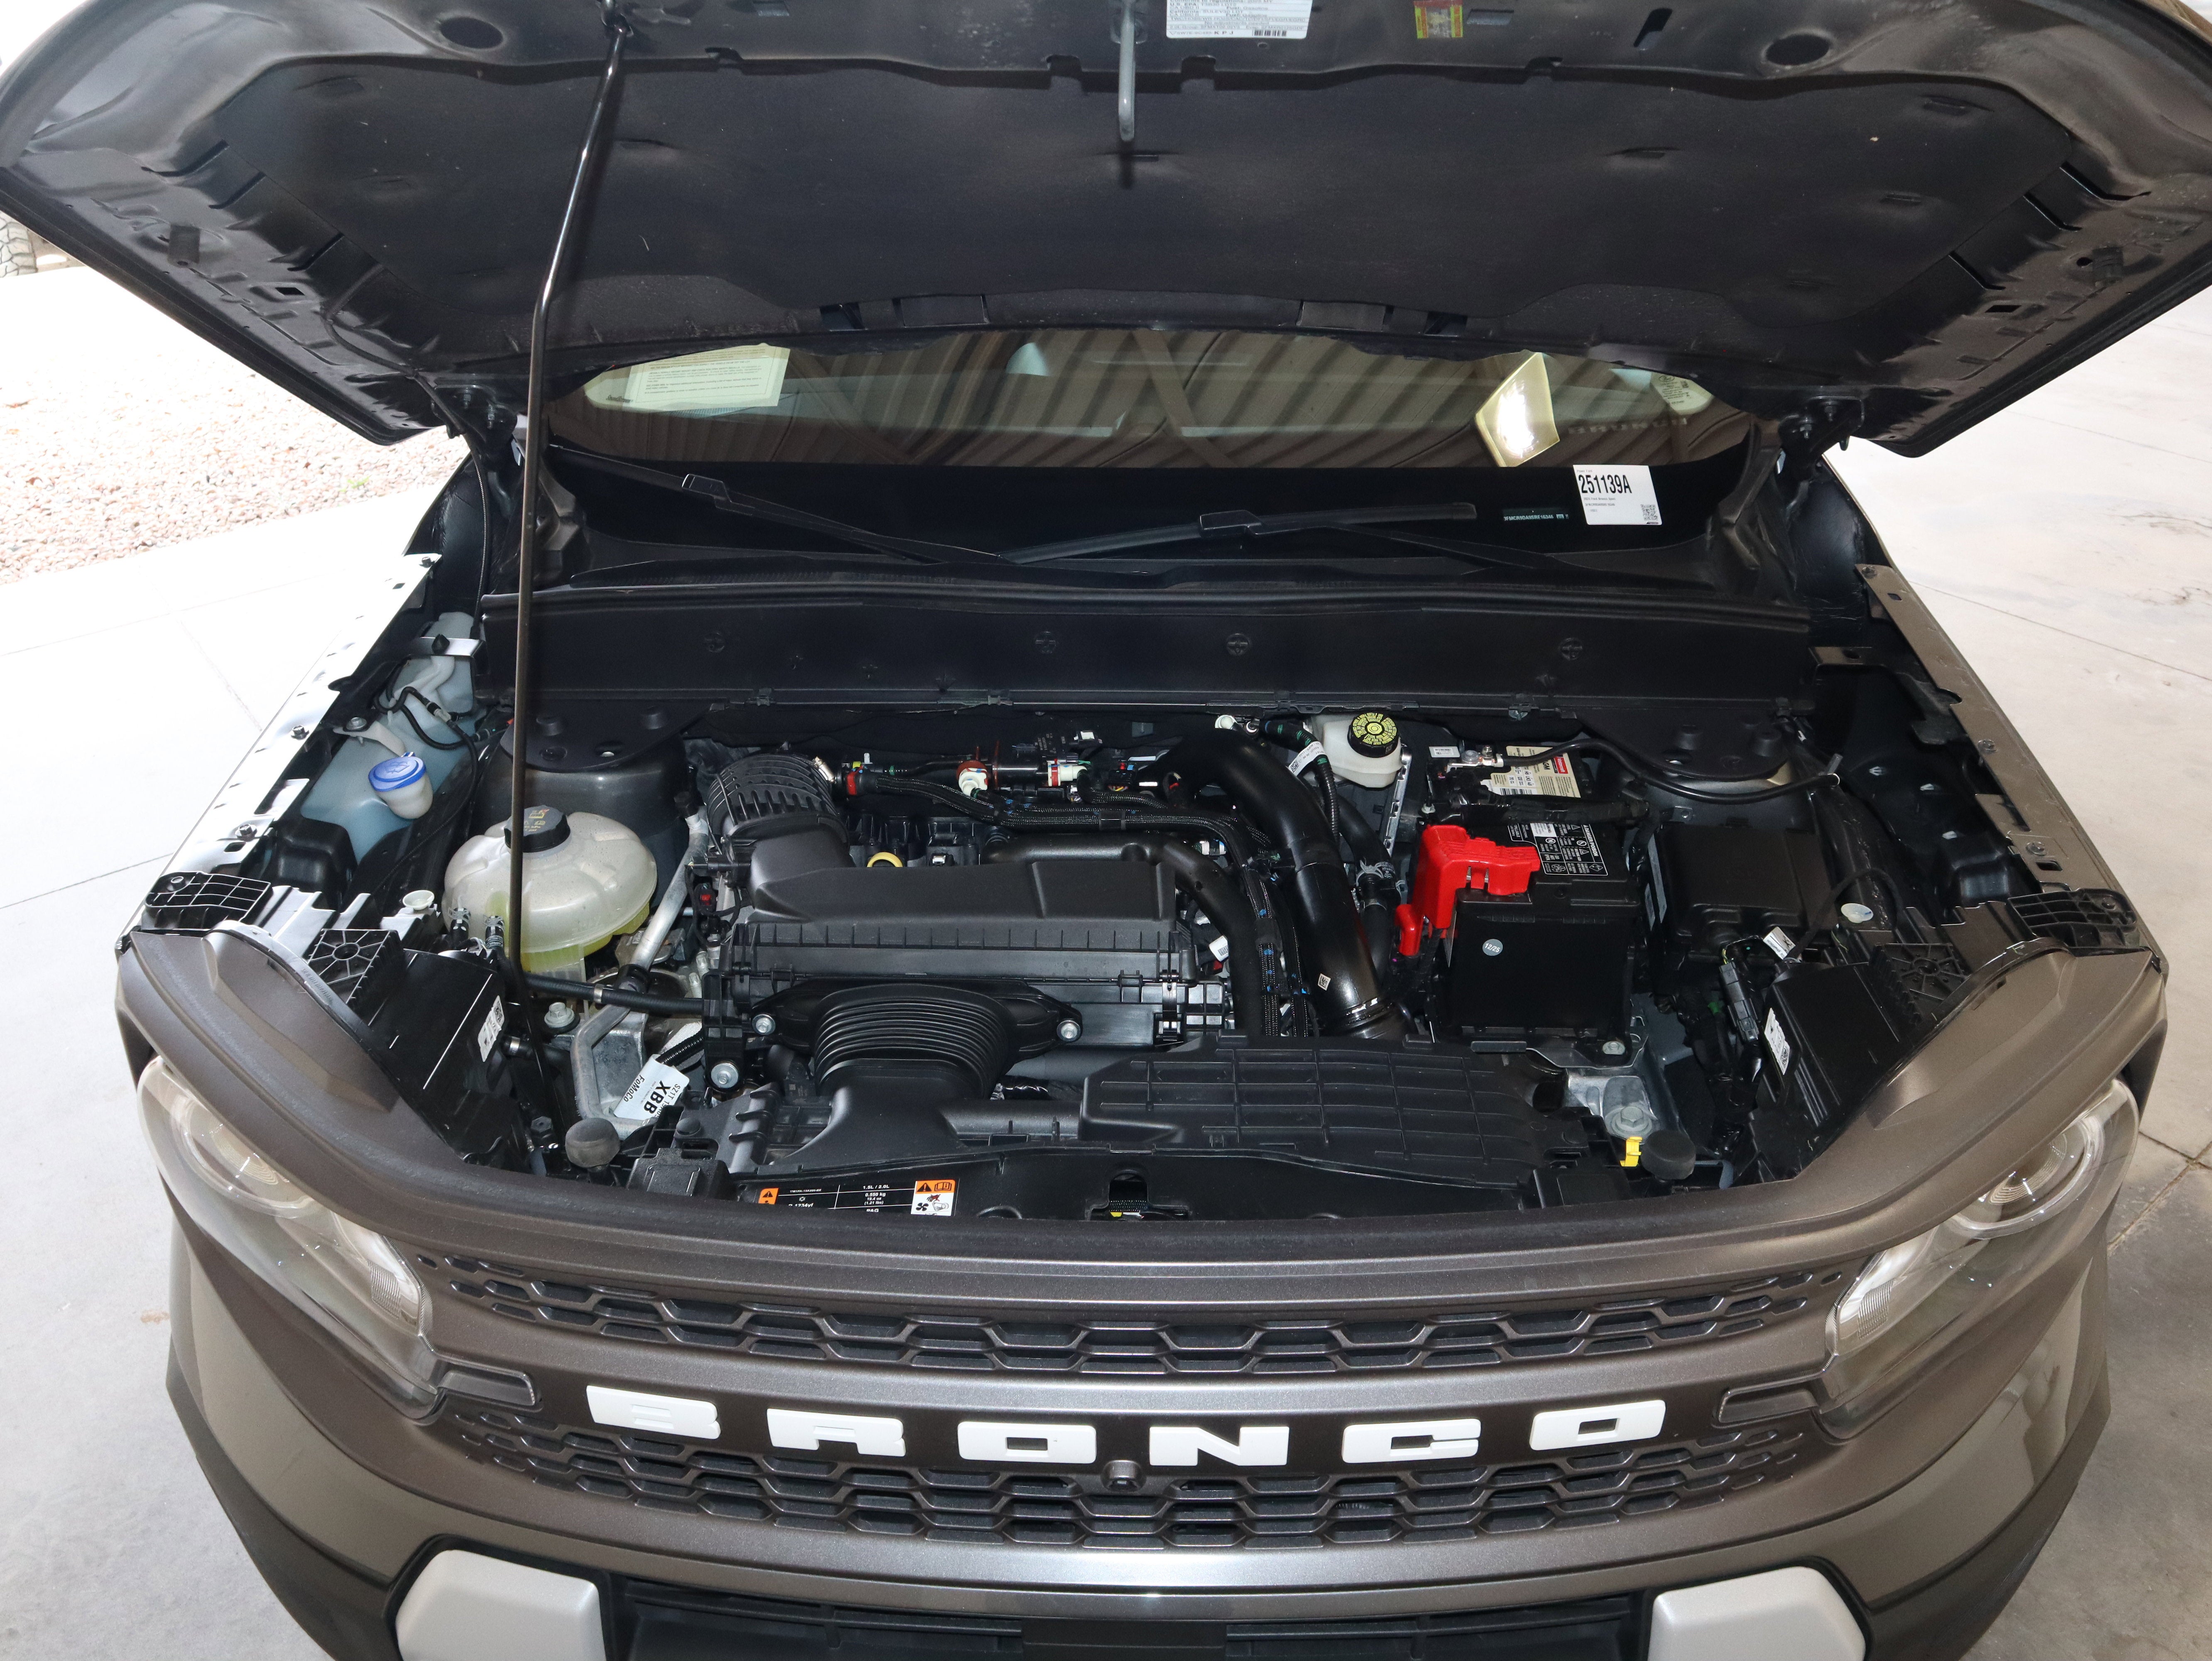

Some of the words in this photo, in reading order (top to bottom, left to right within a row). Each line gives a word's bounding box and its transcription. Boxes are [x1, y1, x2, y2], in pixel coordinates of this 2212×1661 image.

[1578, 474, 1632, 494] 251139A
[1557, 757, 1566, 773] Motorcraft
[1584, 828, 1599, 856] DANGER/POISON
[1485, 943, 1500, 953] 12/25
[624, 1075, 645, 1102] FoMoCo
[644, 1080, 671, 1114] XBB
[668, 1084, 681, 1100] SZ1T
[586, 1385, 1666, 1467] BRONCO
